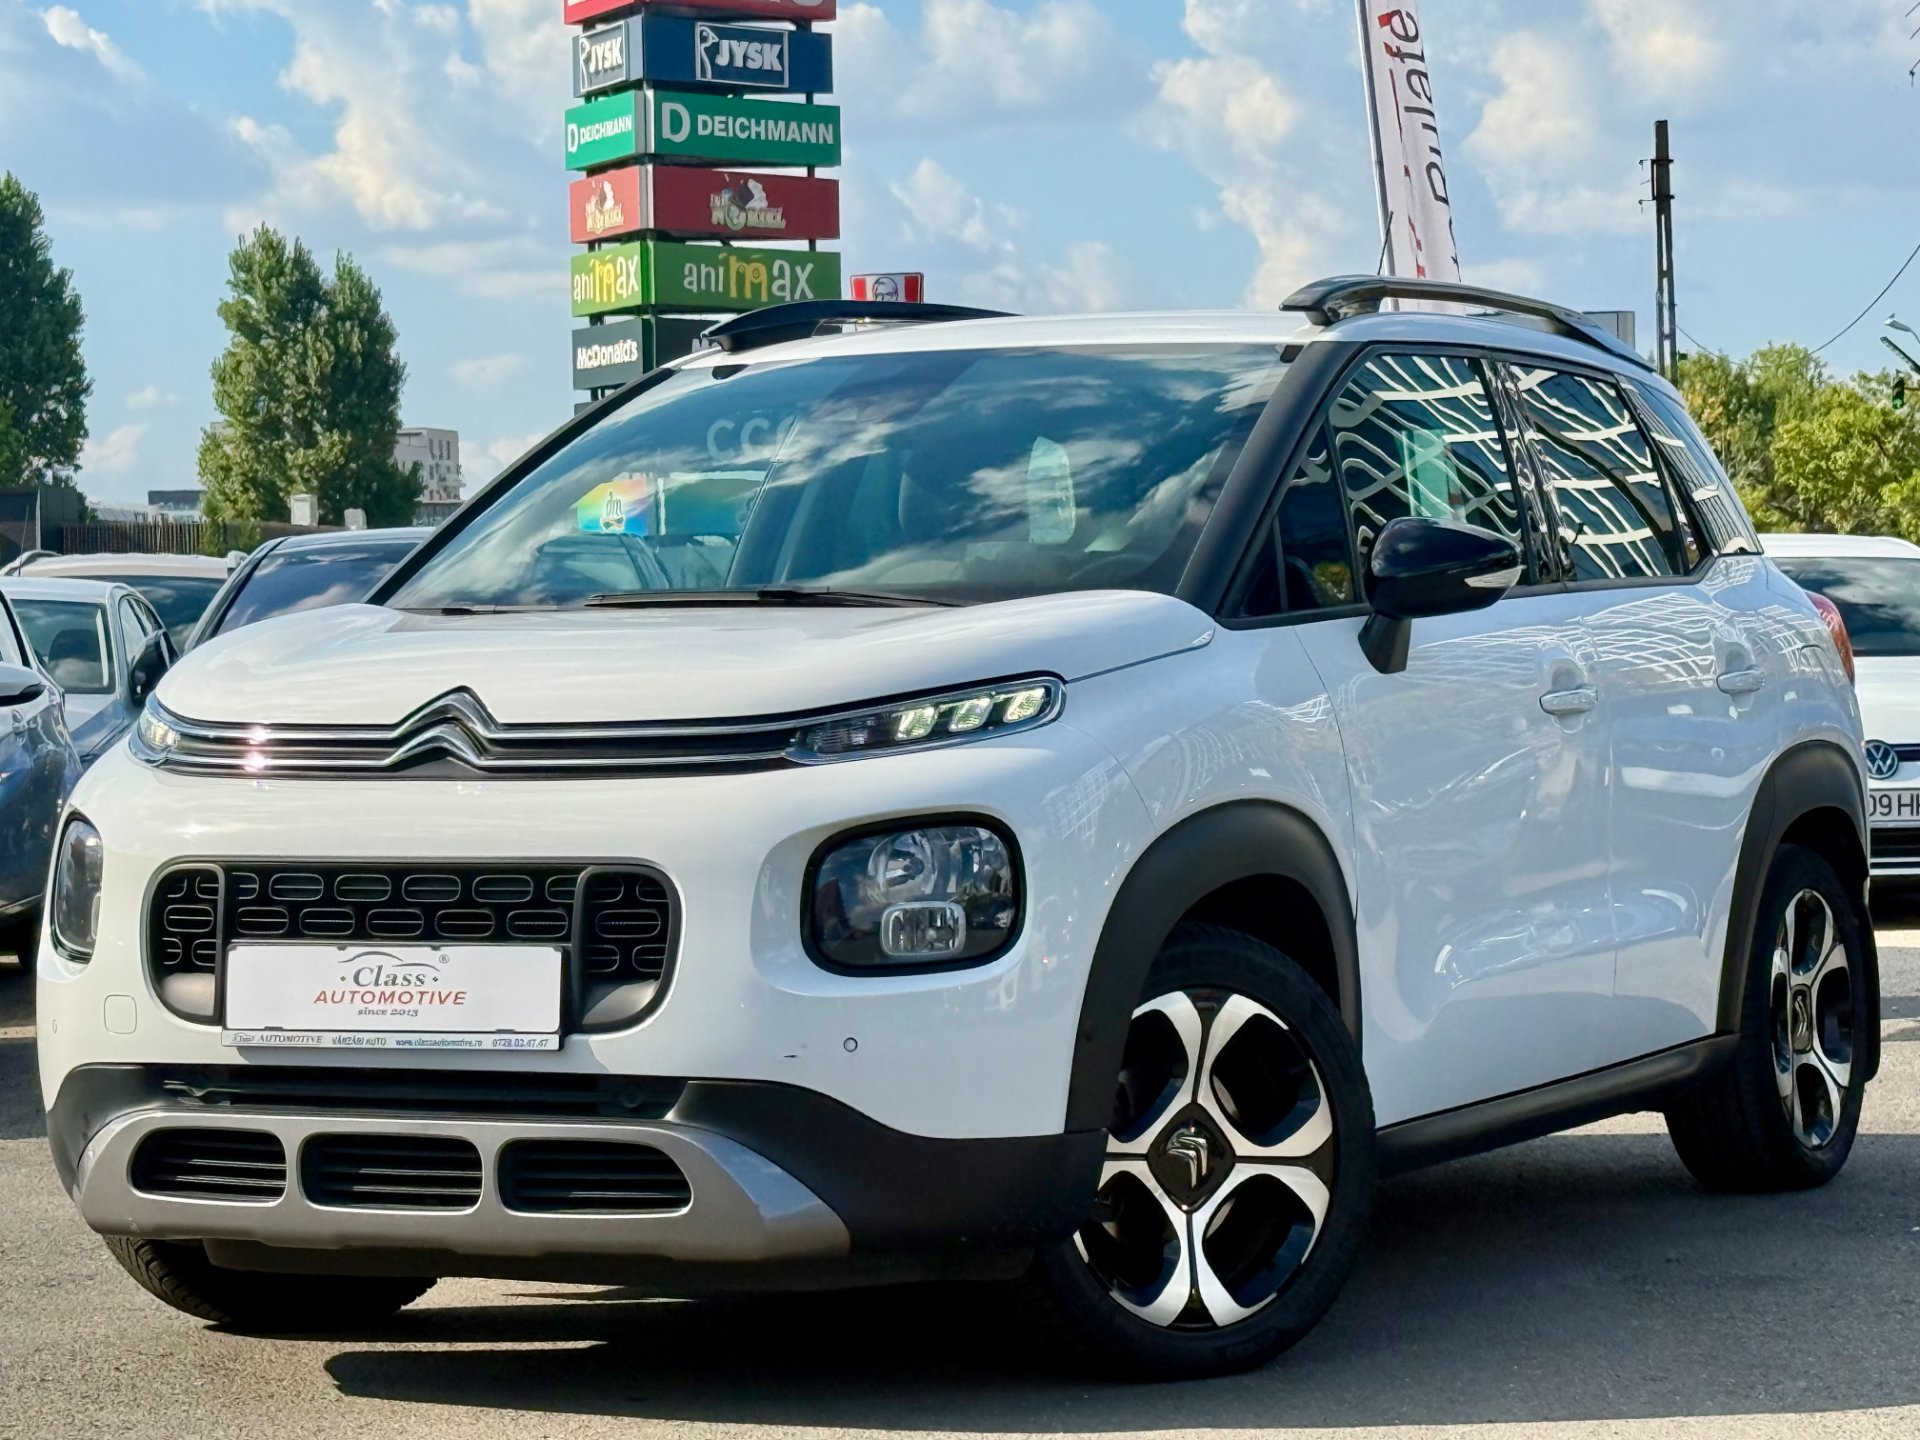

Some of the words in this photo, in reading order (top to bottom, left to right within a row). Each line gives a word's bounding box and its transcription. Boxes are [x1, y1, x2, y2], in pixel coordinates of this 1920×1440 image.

[589, 37, 623, 73] JYSK
[715, 39, 783, 72] JYSK
[580, 114, 632, 144] DEICHMANN
[661, 102, 691, 143] D
[697, 114, 834, 145] DEICHMANN
[573, 254, 639, 303] animax
[683, 252, 814, 303] animax
[576, 338, 639, 370] McDonald's
[353, 964, 427, 987] Class
[314, 990, 468, 1006] AUTOMOTIVE
[357, 1006, 388, 1017] since
[257, 1034, 324, 1045] AUTOMOTIVE
